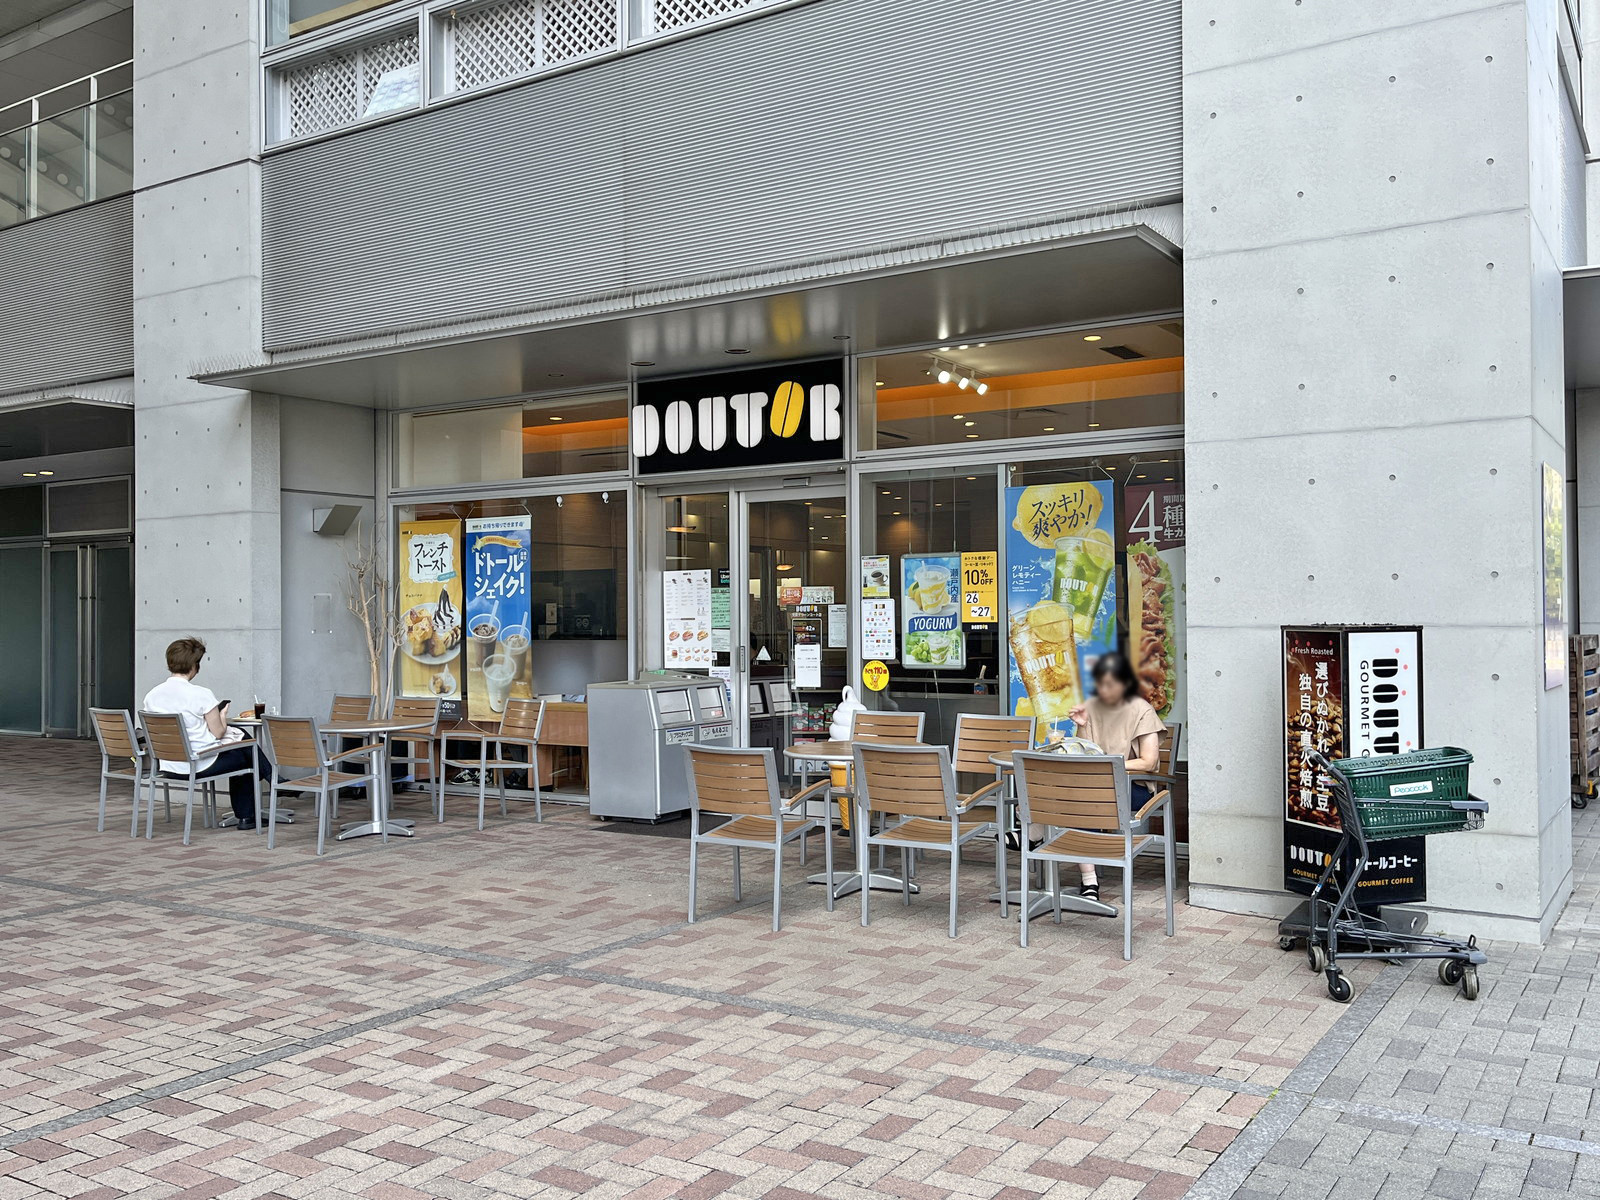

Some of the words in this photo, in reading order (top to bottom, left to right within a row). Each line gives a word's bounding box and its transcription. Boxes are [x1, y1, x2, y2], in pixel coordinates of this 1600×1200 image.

[632, 380, 841, 458] DOUTOR
[1029, 489, 1085, 523] スッキリ
[1032, 504, 1093, 542] 爽やか!
[1163, 528, 1186, 539] 牛カ
[413, 541, 449, 559] フレンチ
[416, 557, 447, 574] トースト
[475, 552, 525, 576] ドトール
[1012, 564, 1036, 572] グリーン
[473, 572, 525, 599] シェイク!
[950, 568, 959, 603] 瀬戸内産
[980, 578, 994, 586] OFF
[966, 593, 979, 604] 26
[795, 604, 818, 613] DOUTOR
[913, 617, 953, 631] YOGURN
[1295, 646, 1310, 655] Fresh
[1310, 647, 1334, 656] Roasted
[1360, 660, 1370, 740] GOURMET
[1299, 673, 1313, 809] 独自の直火焙煎
[1394, 784, 1429, 794] Peacock
[1292, 868, 1318, 880] GOURMET
[1357, 879, 1389, 888] GOURMET
[1391, 876, 1414, 886] COFFEE
